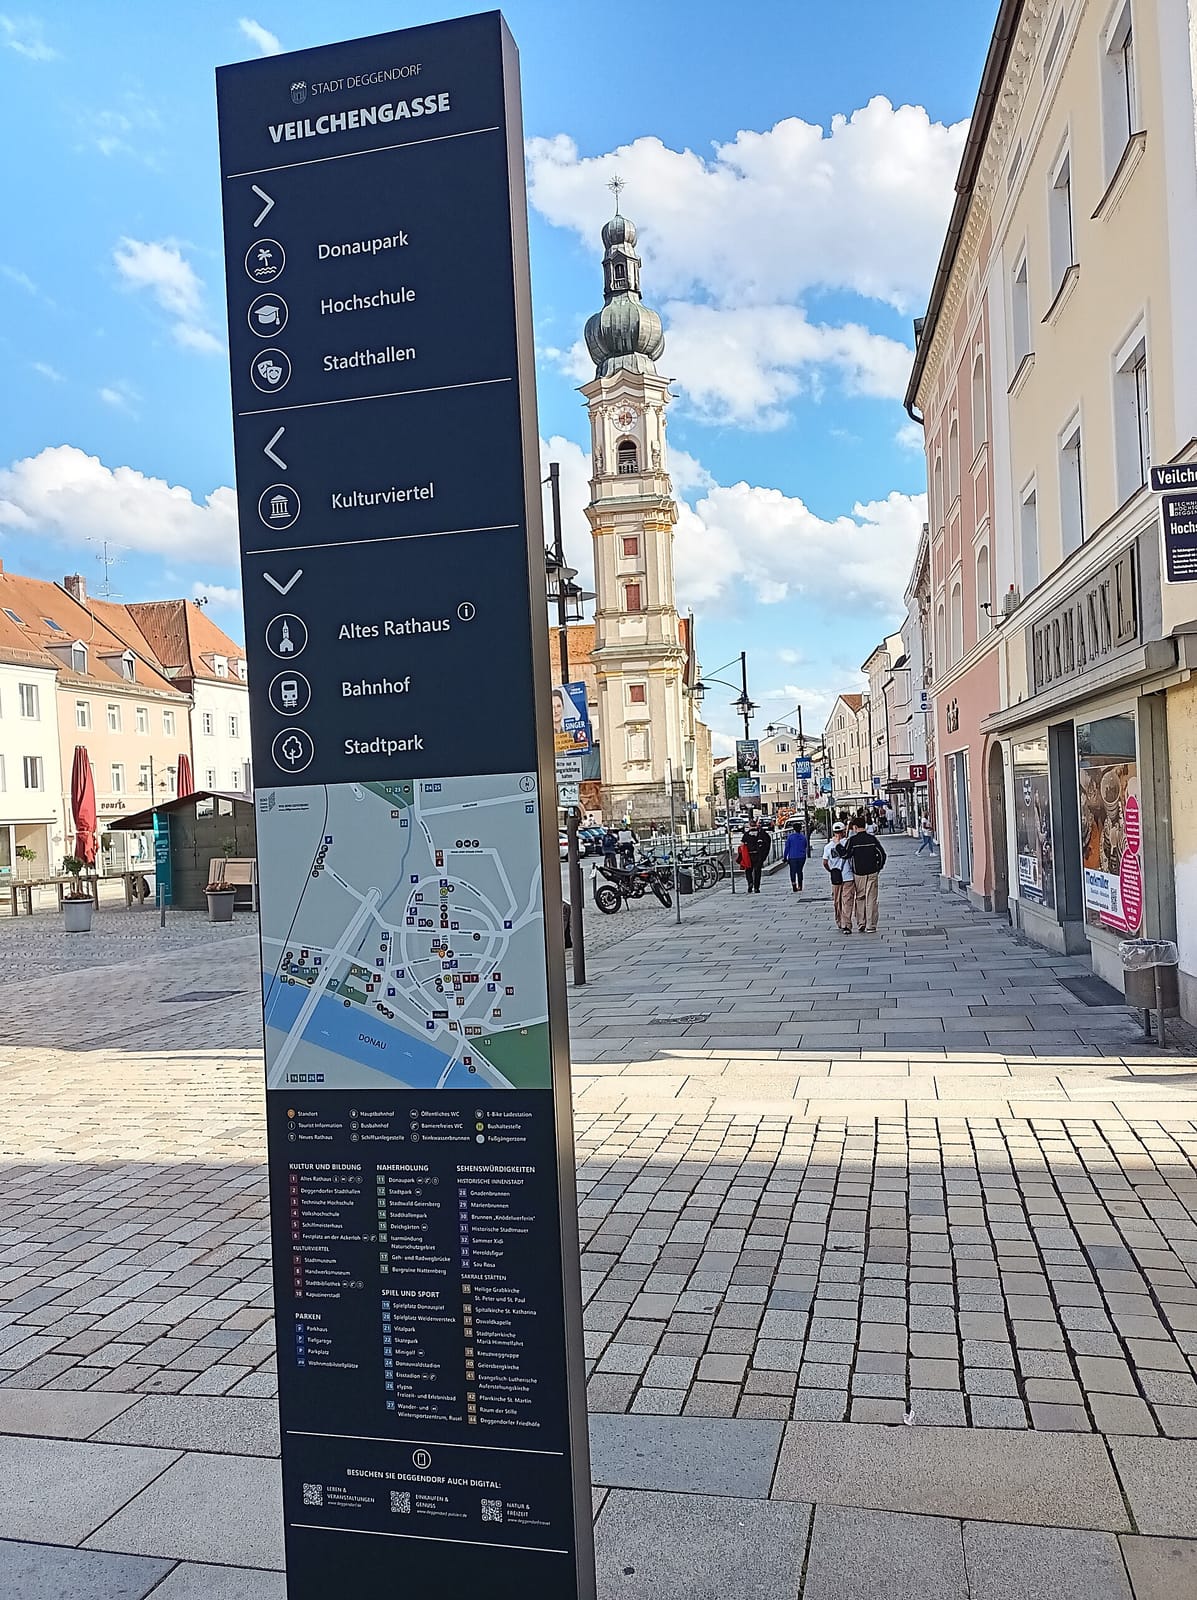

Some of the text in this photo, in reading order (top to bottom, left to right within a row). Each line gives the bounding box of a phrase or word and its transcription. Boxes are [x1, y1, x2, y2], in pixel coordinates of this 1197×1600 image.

[311, 64, 422, 96] STADT DEGGENDORF
[268, 93, 450, 143] VEILCHENGASSE
[318, 231, 409, 259] Donaupark
[321, 287, 416, 315] Hochschule
[323, 346, 416, 371] Stadthallen
[1157, 468, 1197, 485] Veilch
[332, 484, 435, 509] Kulturviertel
[338, 618, 450, 640] Altes Rathaus
[342, 677, 410, 697] Bahnhof
[565, 721, 585, 730] SINGER
[344, 735, 423, 755] Stadtpark
[359, 1034, 387, 1049] DONAU
[457, 1165, 535, 1173] SEHENSWÜRDIGKEITEN
[347, 1469, 501, 1488] BESUCHEN SIE DEGGENDORF AUCH DIGITAL:
[327, 1494, 375, 1503] VERANSTALTUNGEN
